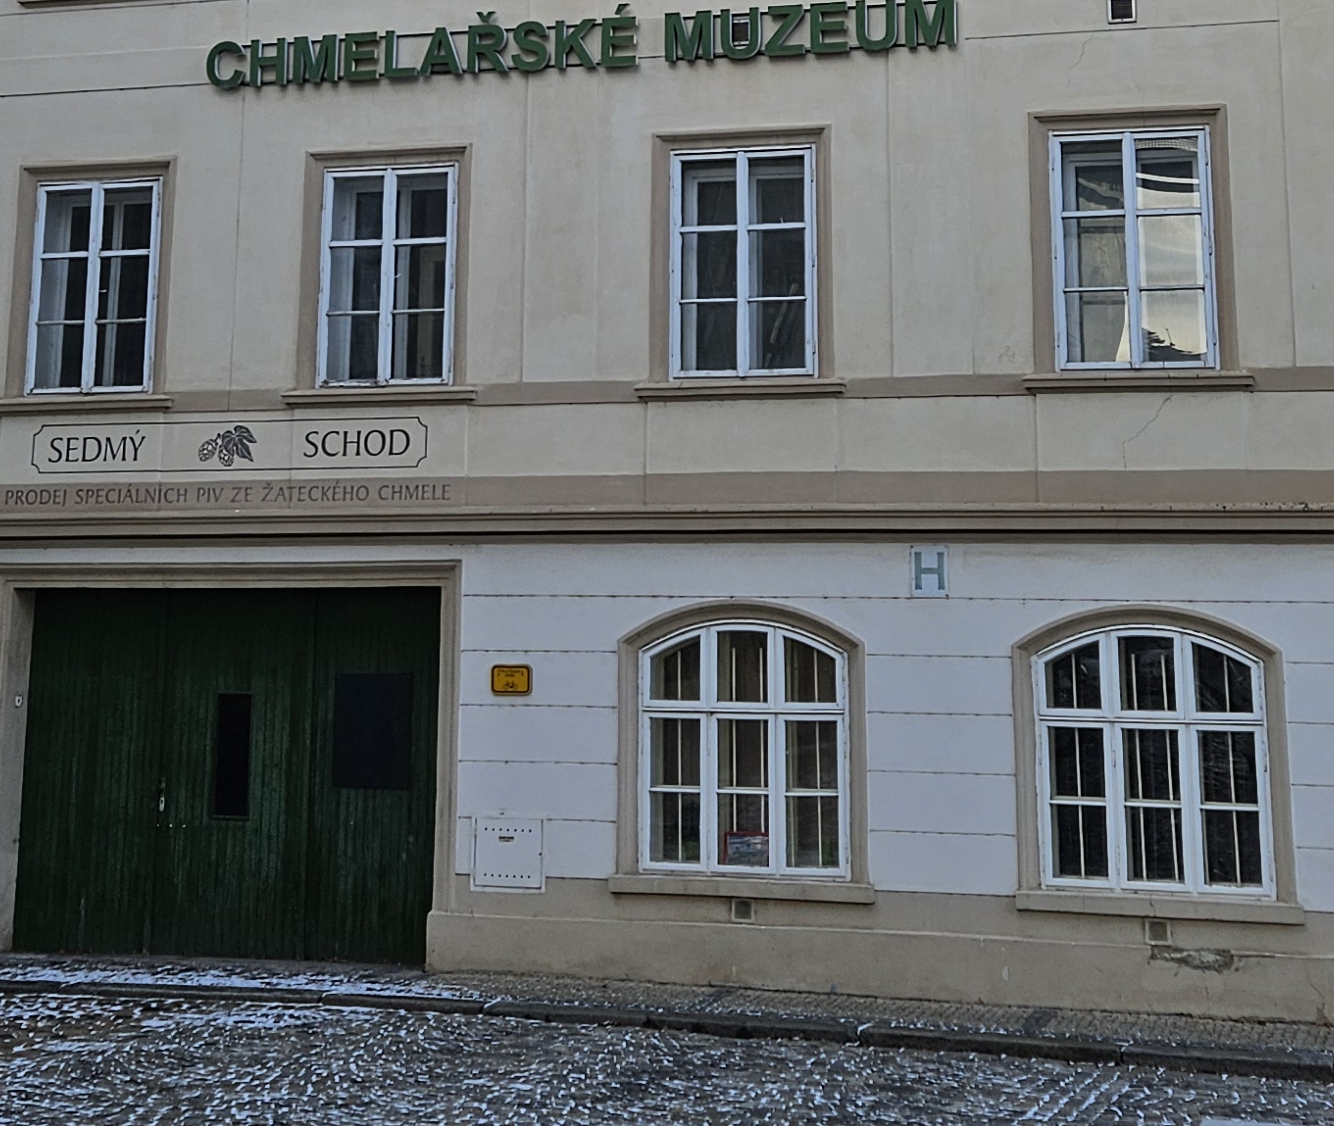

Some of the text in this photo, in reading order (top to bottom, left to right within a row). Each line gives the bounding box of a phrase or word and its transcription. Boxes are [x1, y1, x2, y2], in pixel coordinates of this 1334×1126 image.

[205, 3, 639, 91] CHMELAŘSKÉ
[47, 427, 411, 463] SEDMÝ SCHOD
[4, 481, 451, 507] PRODEJ SPECIÁLNÍCH PIV ZE ŽATECKÉHO CHMELE
[914, 551, 945, 590] H
